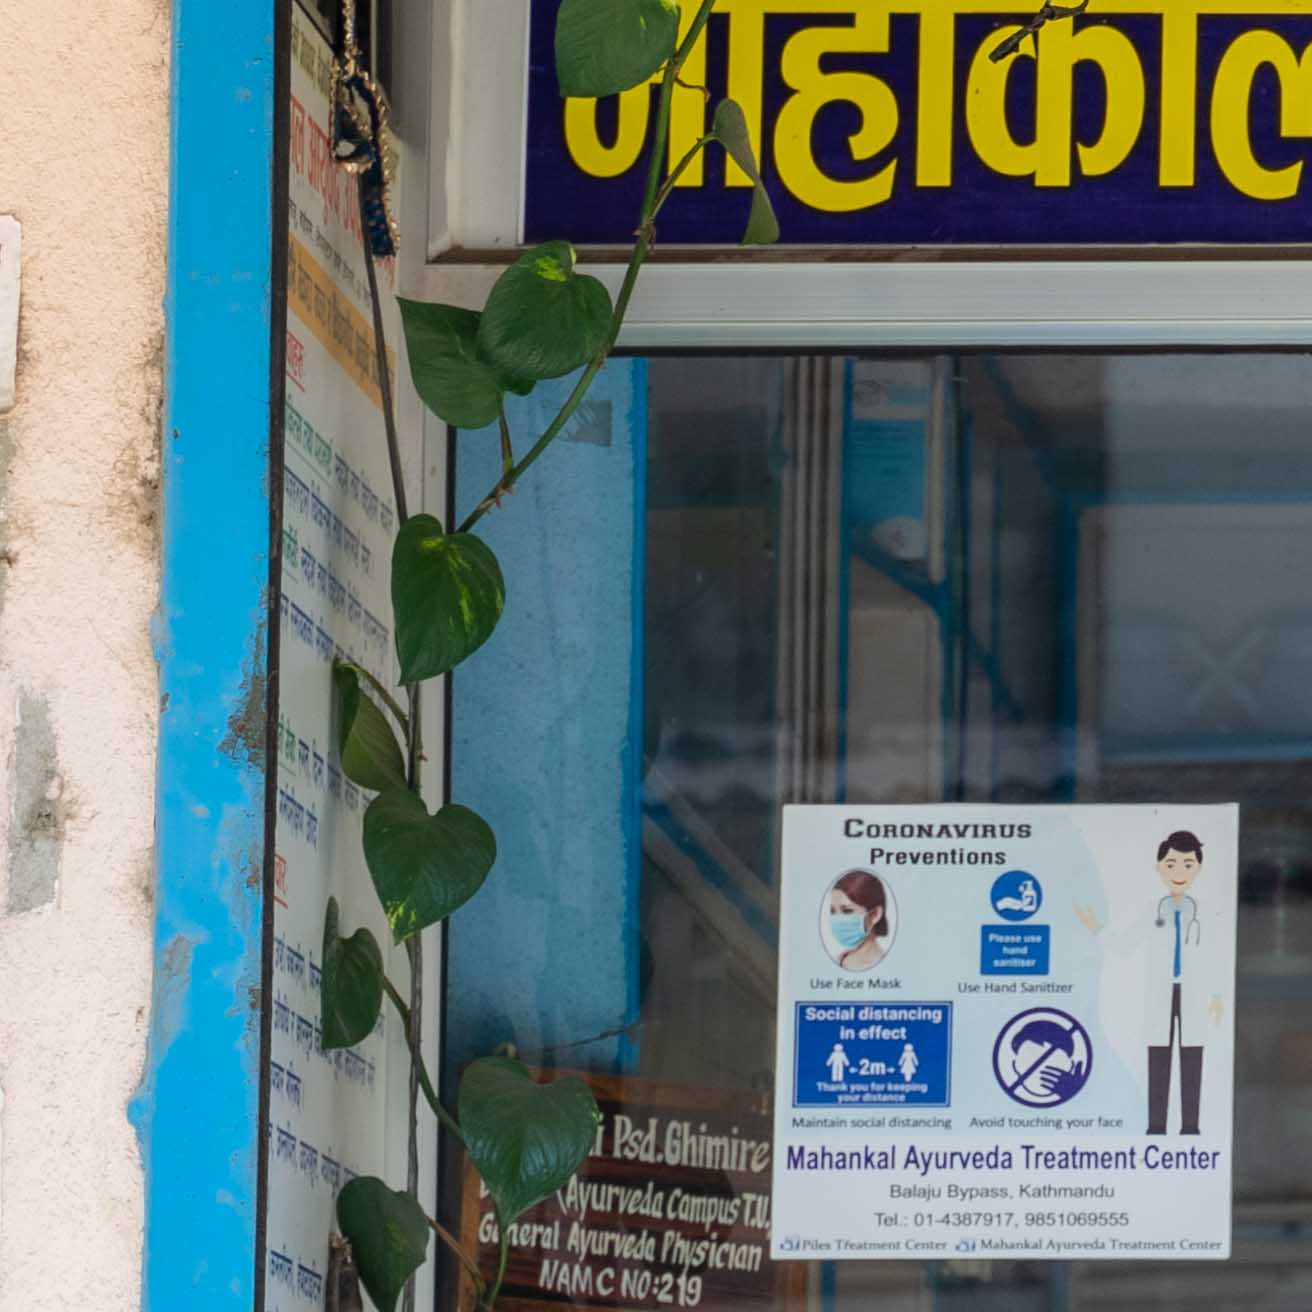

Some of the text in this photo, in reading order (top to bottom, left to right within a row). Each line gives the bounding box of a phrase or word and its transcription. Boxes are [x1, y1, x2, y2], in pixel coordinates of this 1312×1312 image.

[843, 818, 1033, 840] CORONAVIRUS
[869, 847, 1007, 867] Preventions
[810, 977, 903, 991] Use Face Mask
[957, 981, 1074, 995] Use Hand Sanitizer
[805, 1006, 943, 1025] Social distancing
[840, 1026, 907, 1041] in effect
[859, 1058, 887, 1077] 2m
[792, 1116, 953, 1131] Maintain social distancing
[969, 1116, 1124, 1131] Avoid touching your face
[786, 1144, 1222, 1176] Mahankal Ayurveda Treatment Center
[889, 1183, 1116, 1202] Balaju Bypass, Kathmandu
[666, 1188, 741, 1226] Campus
[874, 1212, 1130, 1230] Tel.: 01-4387917, 9851069555
[566, 1222, 655, 1262] Ayurveda
[660, 1231, 763, 1275] Physician
[802, 1239, 948, 1252] Piles Treatment Center
[980, 1239, 1223, 1254] Mahankal Ayurveda Treatment Center
